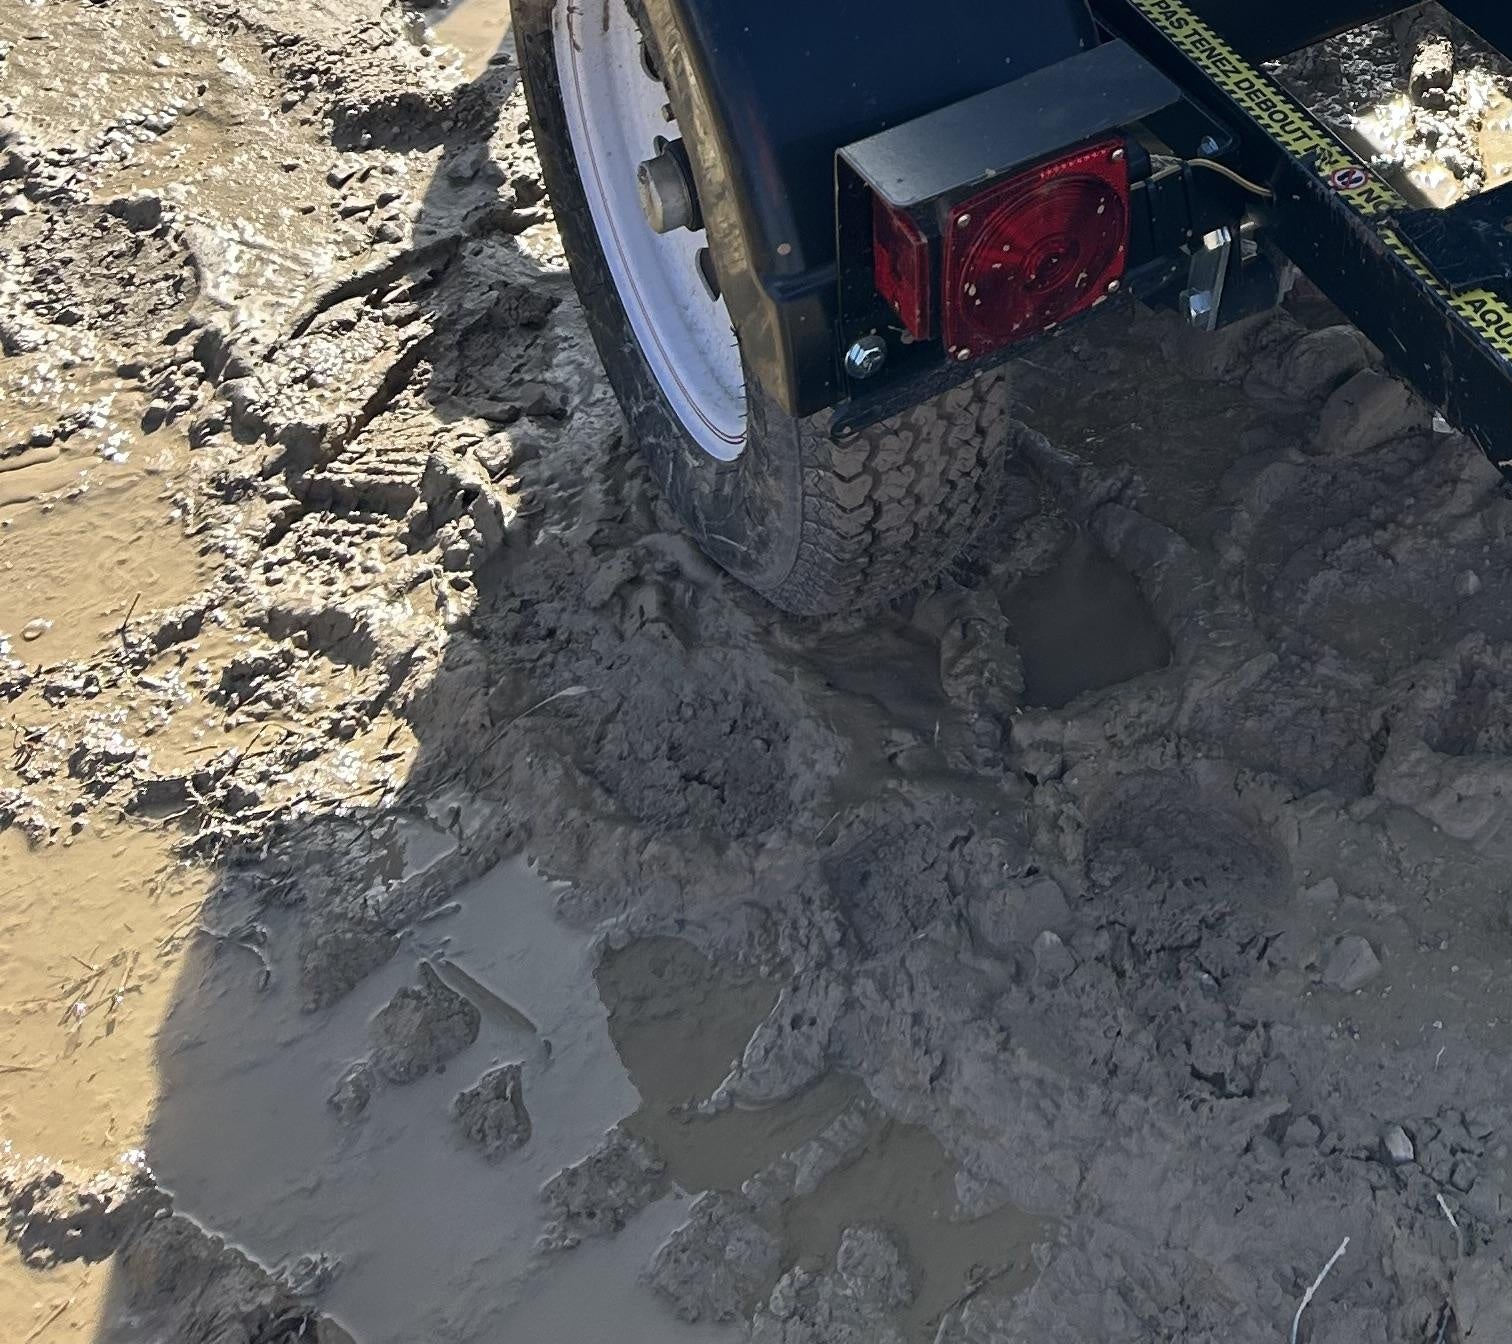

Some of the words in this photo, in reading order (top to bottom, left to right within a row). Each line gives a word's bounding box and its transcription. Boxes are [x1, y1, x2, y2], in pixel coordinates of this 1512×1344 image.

[1151, 0, 1189, 30] PAS
[1184, 28, 1241, 79] TENEZ
[1233, 77, 1311, 143] DEBOUT
